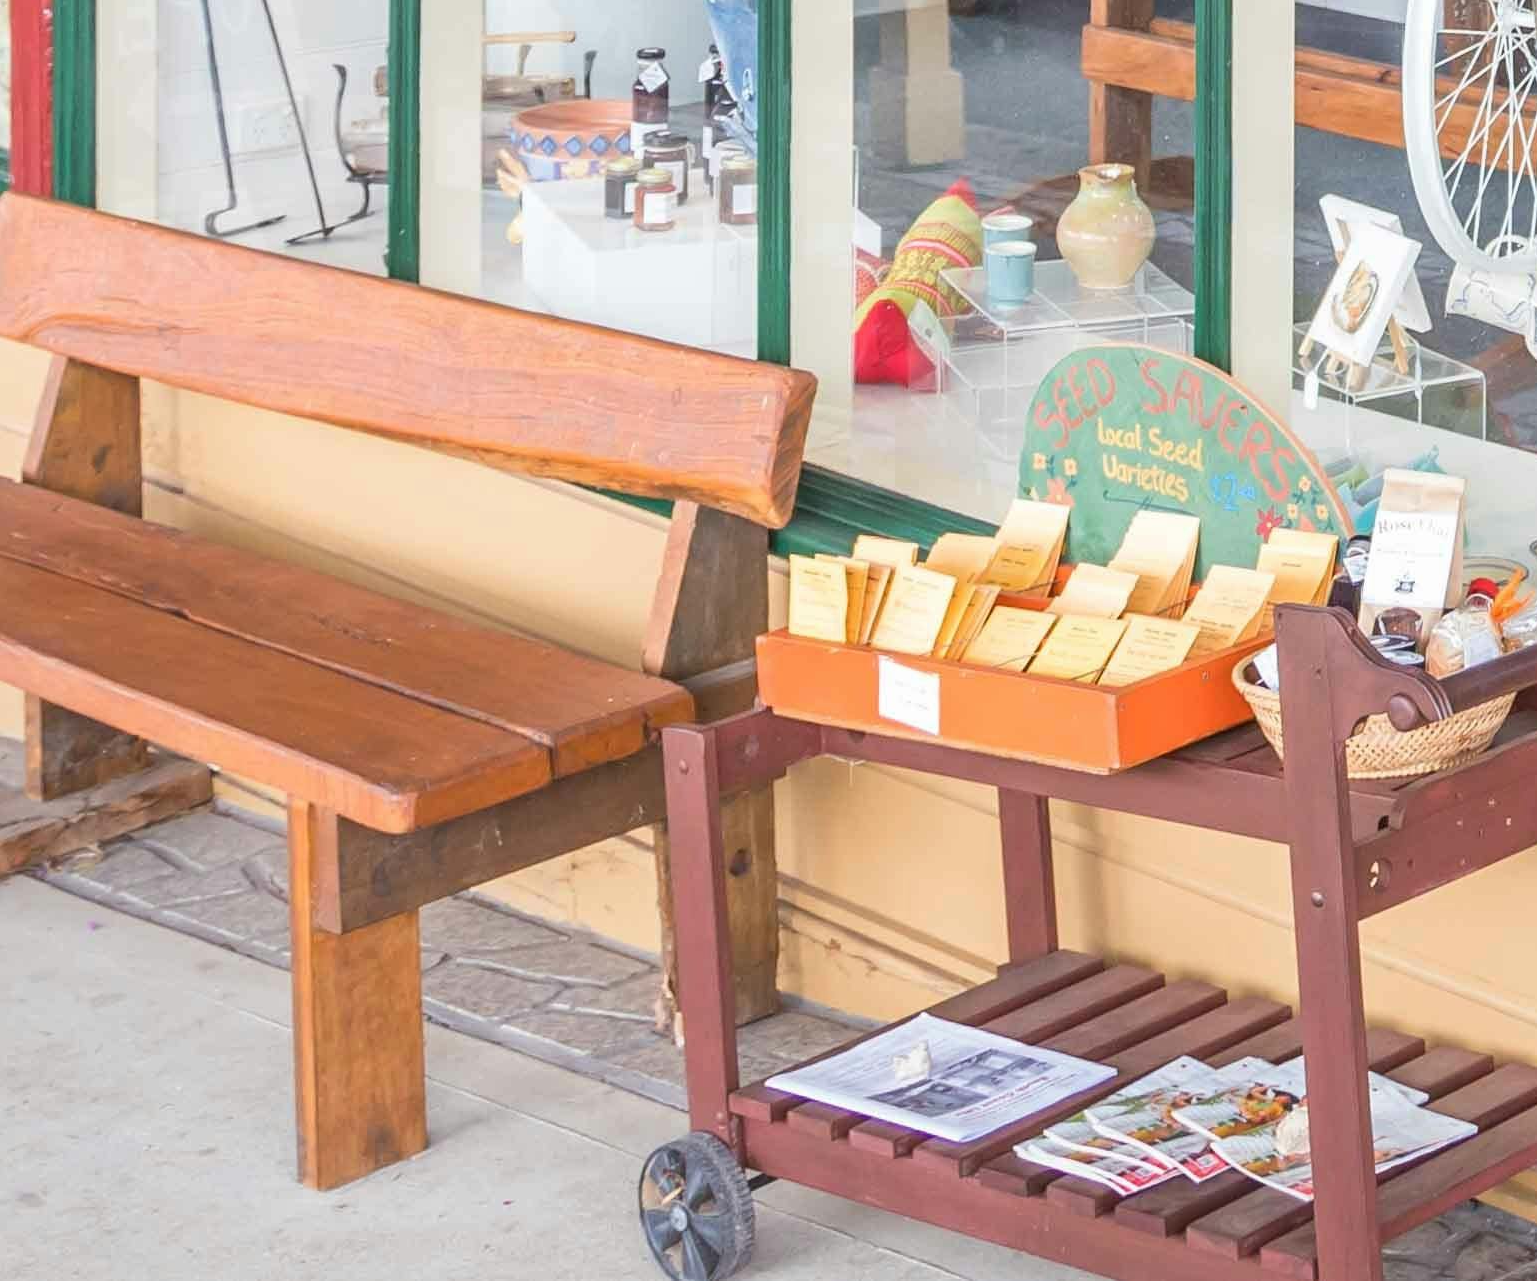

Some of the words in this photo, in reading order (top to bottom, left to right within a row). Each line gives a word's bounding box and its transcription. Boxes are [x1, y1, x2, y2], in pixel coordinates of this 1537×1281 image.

[1033, 357, 1117, 449] SEED
[1139, 356, 1295, 502] SAVERS
[1096, 416, 1142, 453] Local
[1148, 427, 1204, 472] Seed
[1102, 453, 1190, 503] Varieties
